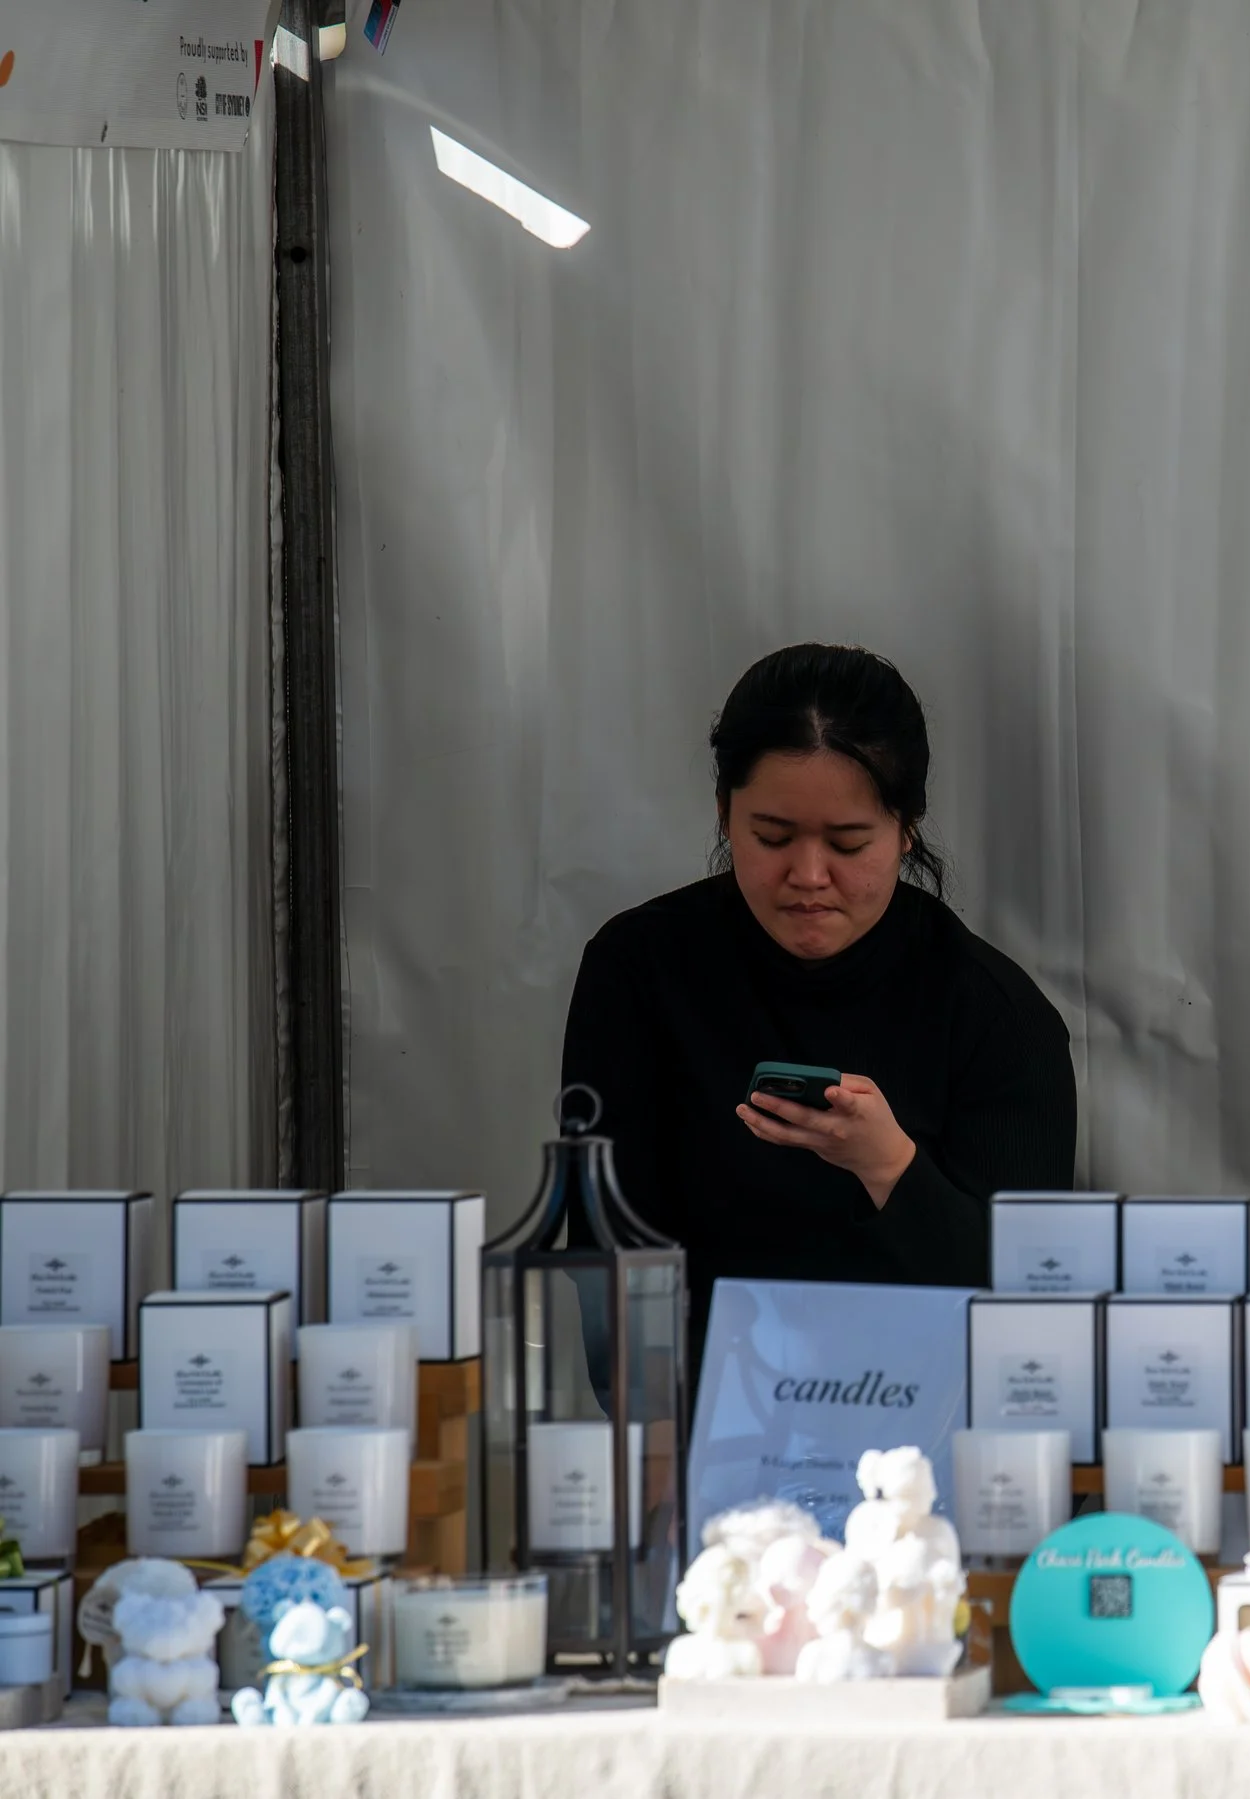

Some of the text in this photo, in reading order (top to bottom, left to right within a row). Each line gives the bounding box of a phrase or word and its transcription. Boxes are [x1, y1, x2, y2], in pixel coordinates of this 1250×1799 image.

[240, 41, 248, 68] by
[773, 1370, 920, 1408] candles
[1037, 1548, 1083, 1569] Chase
[1125, 1548, 1188, 1569] Candles
